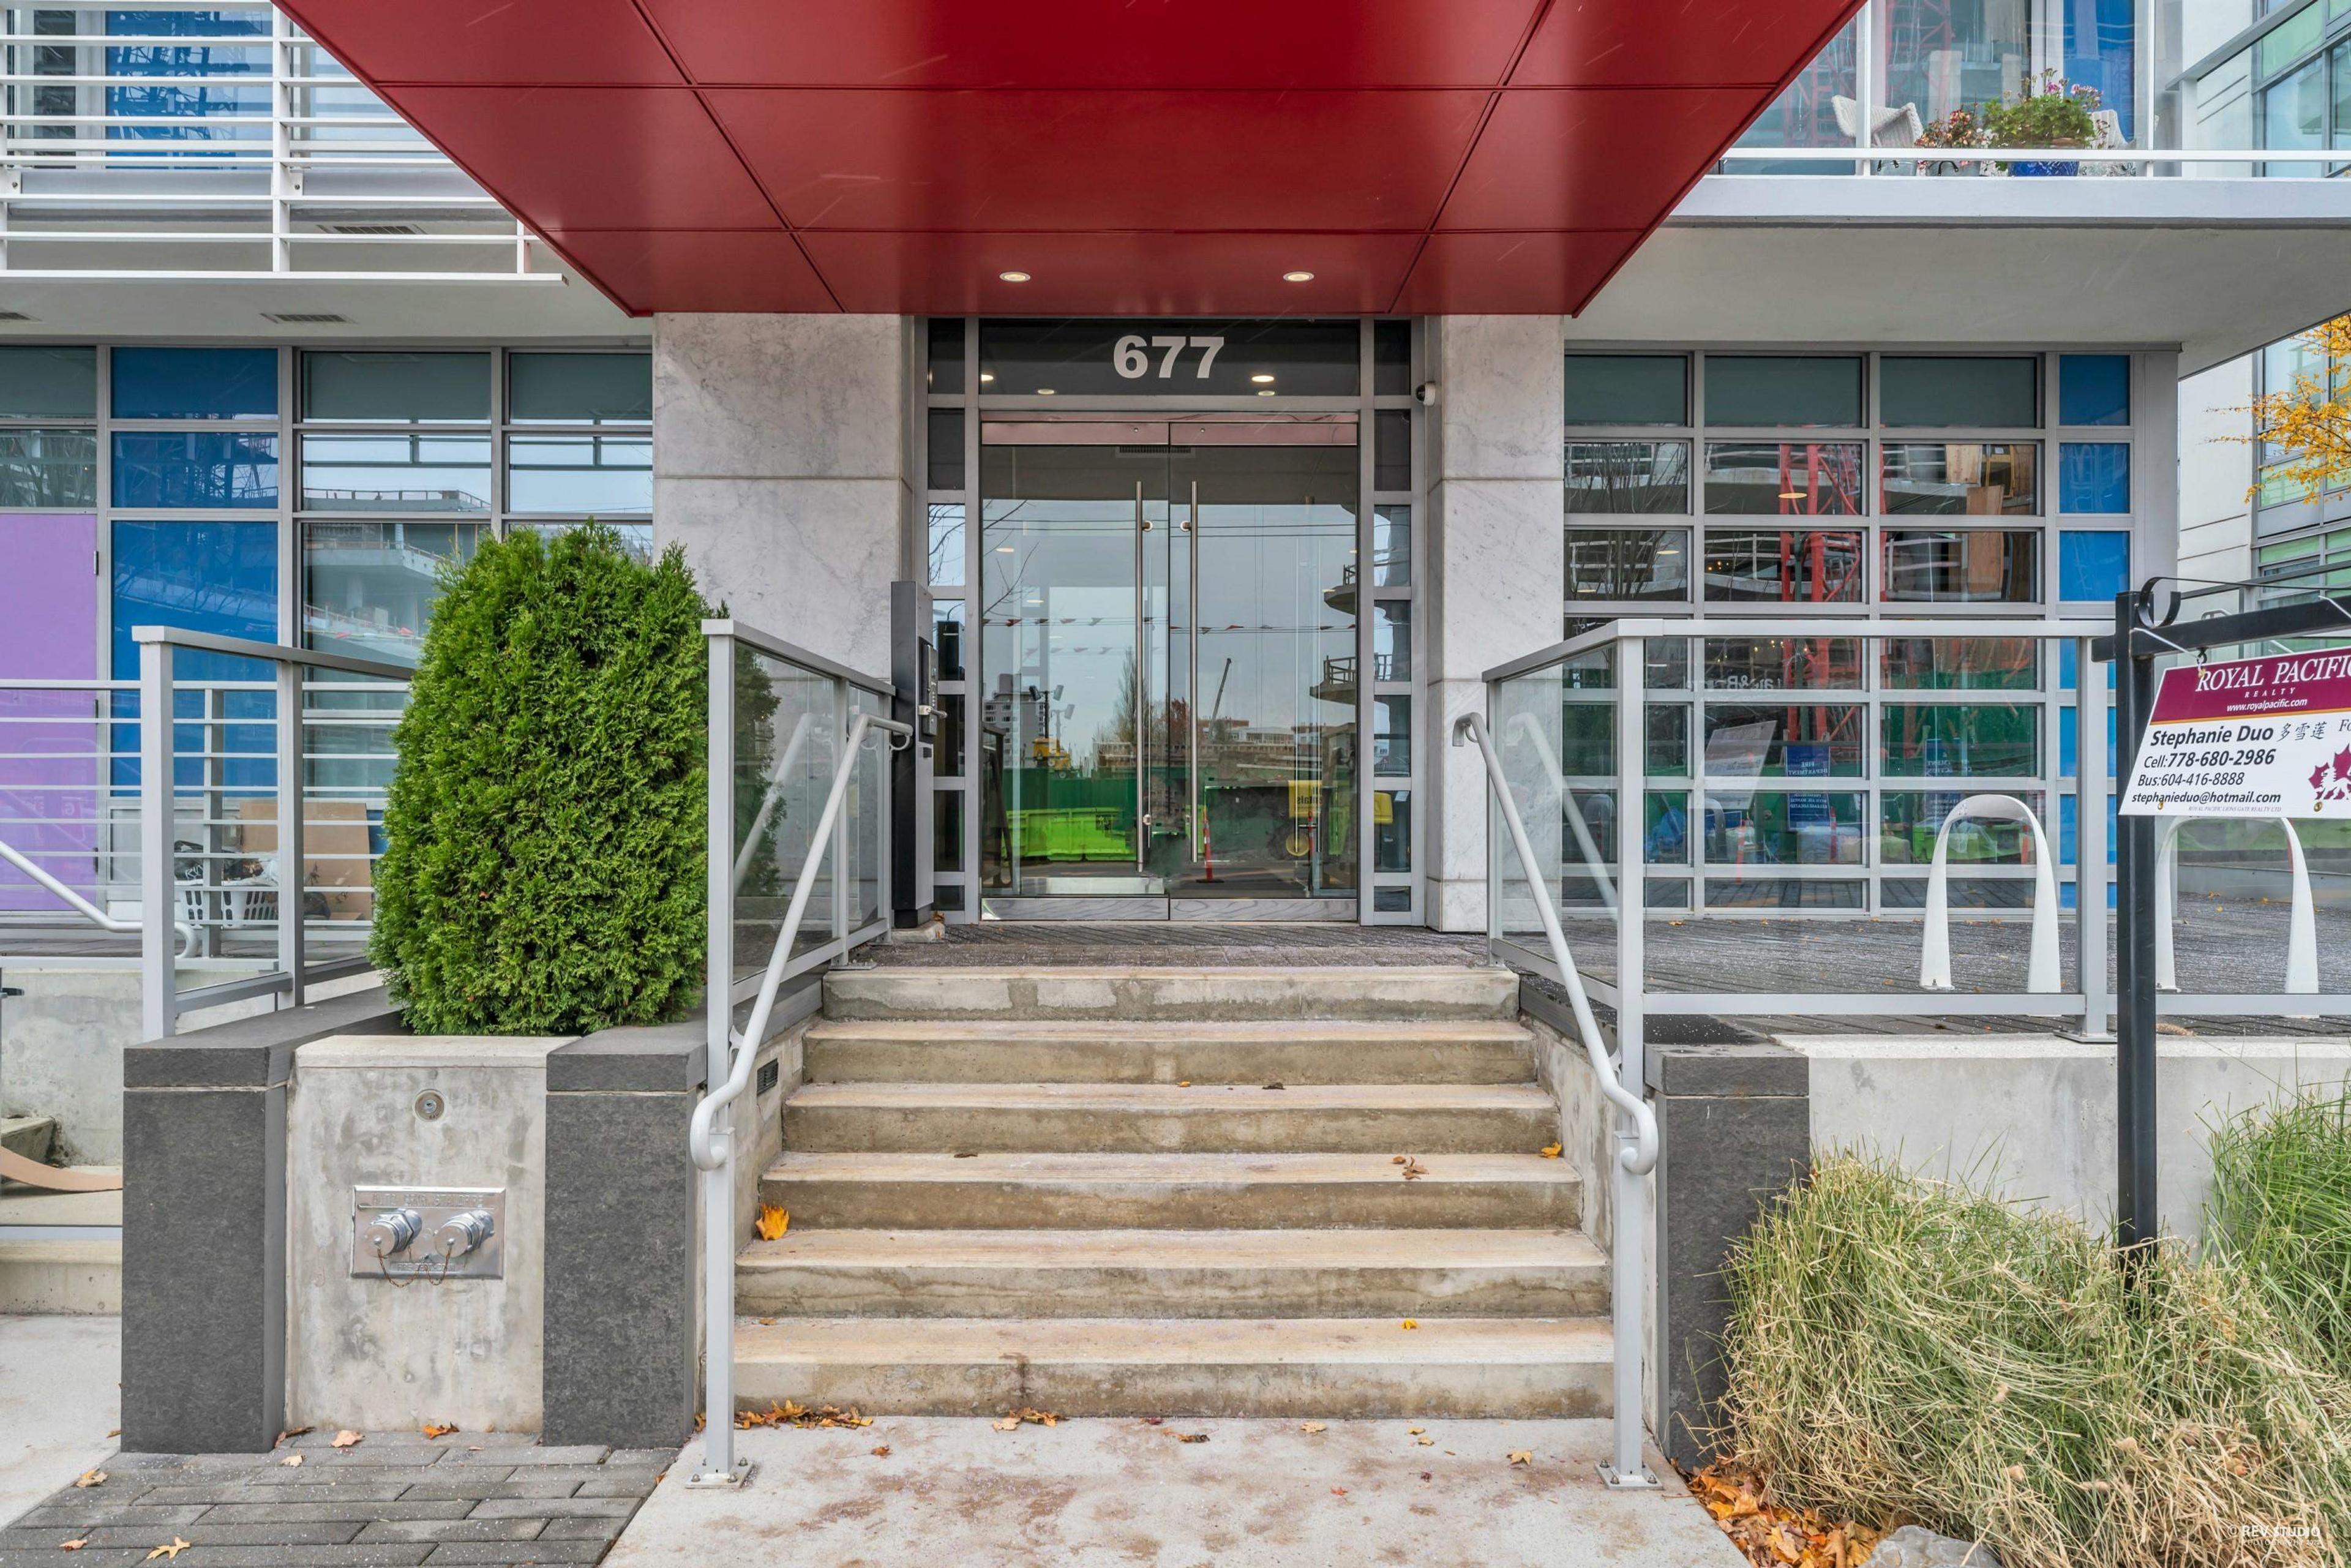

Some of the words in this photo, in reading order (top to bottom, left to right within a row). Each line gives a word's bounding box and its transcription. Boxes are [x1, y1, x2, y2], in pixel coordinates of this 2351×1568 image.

[1113, 335, 1224, 378] 677
[2195, 665, 2265, 692] ROYAL
[2272, 655, 2351, 685] PACIFI
[2244, 687, 2295, 698] REALTY
[2227, 698, 2308, 712] www.royalpacific.com
[2151, 726, 2232, 749] Stephanie
[2237, 726, 2274, 741] Duo
[2144, 749, 2276, 768] Cell:778-680-2986
[2138, 772, 2245, 786] Bus:604-416-8888
[2132, 792, 2281, 805] stephanieduo@hotmail.com
